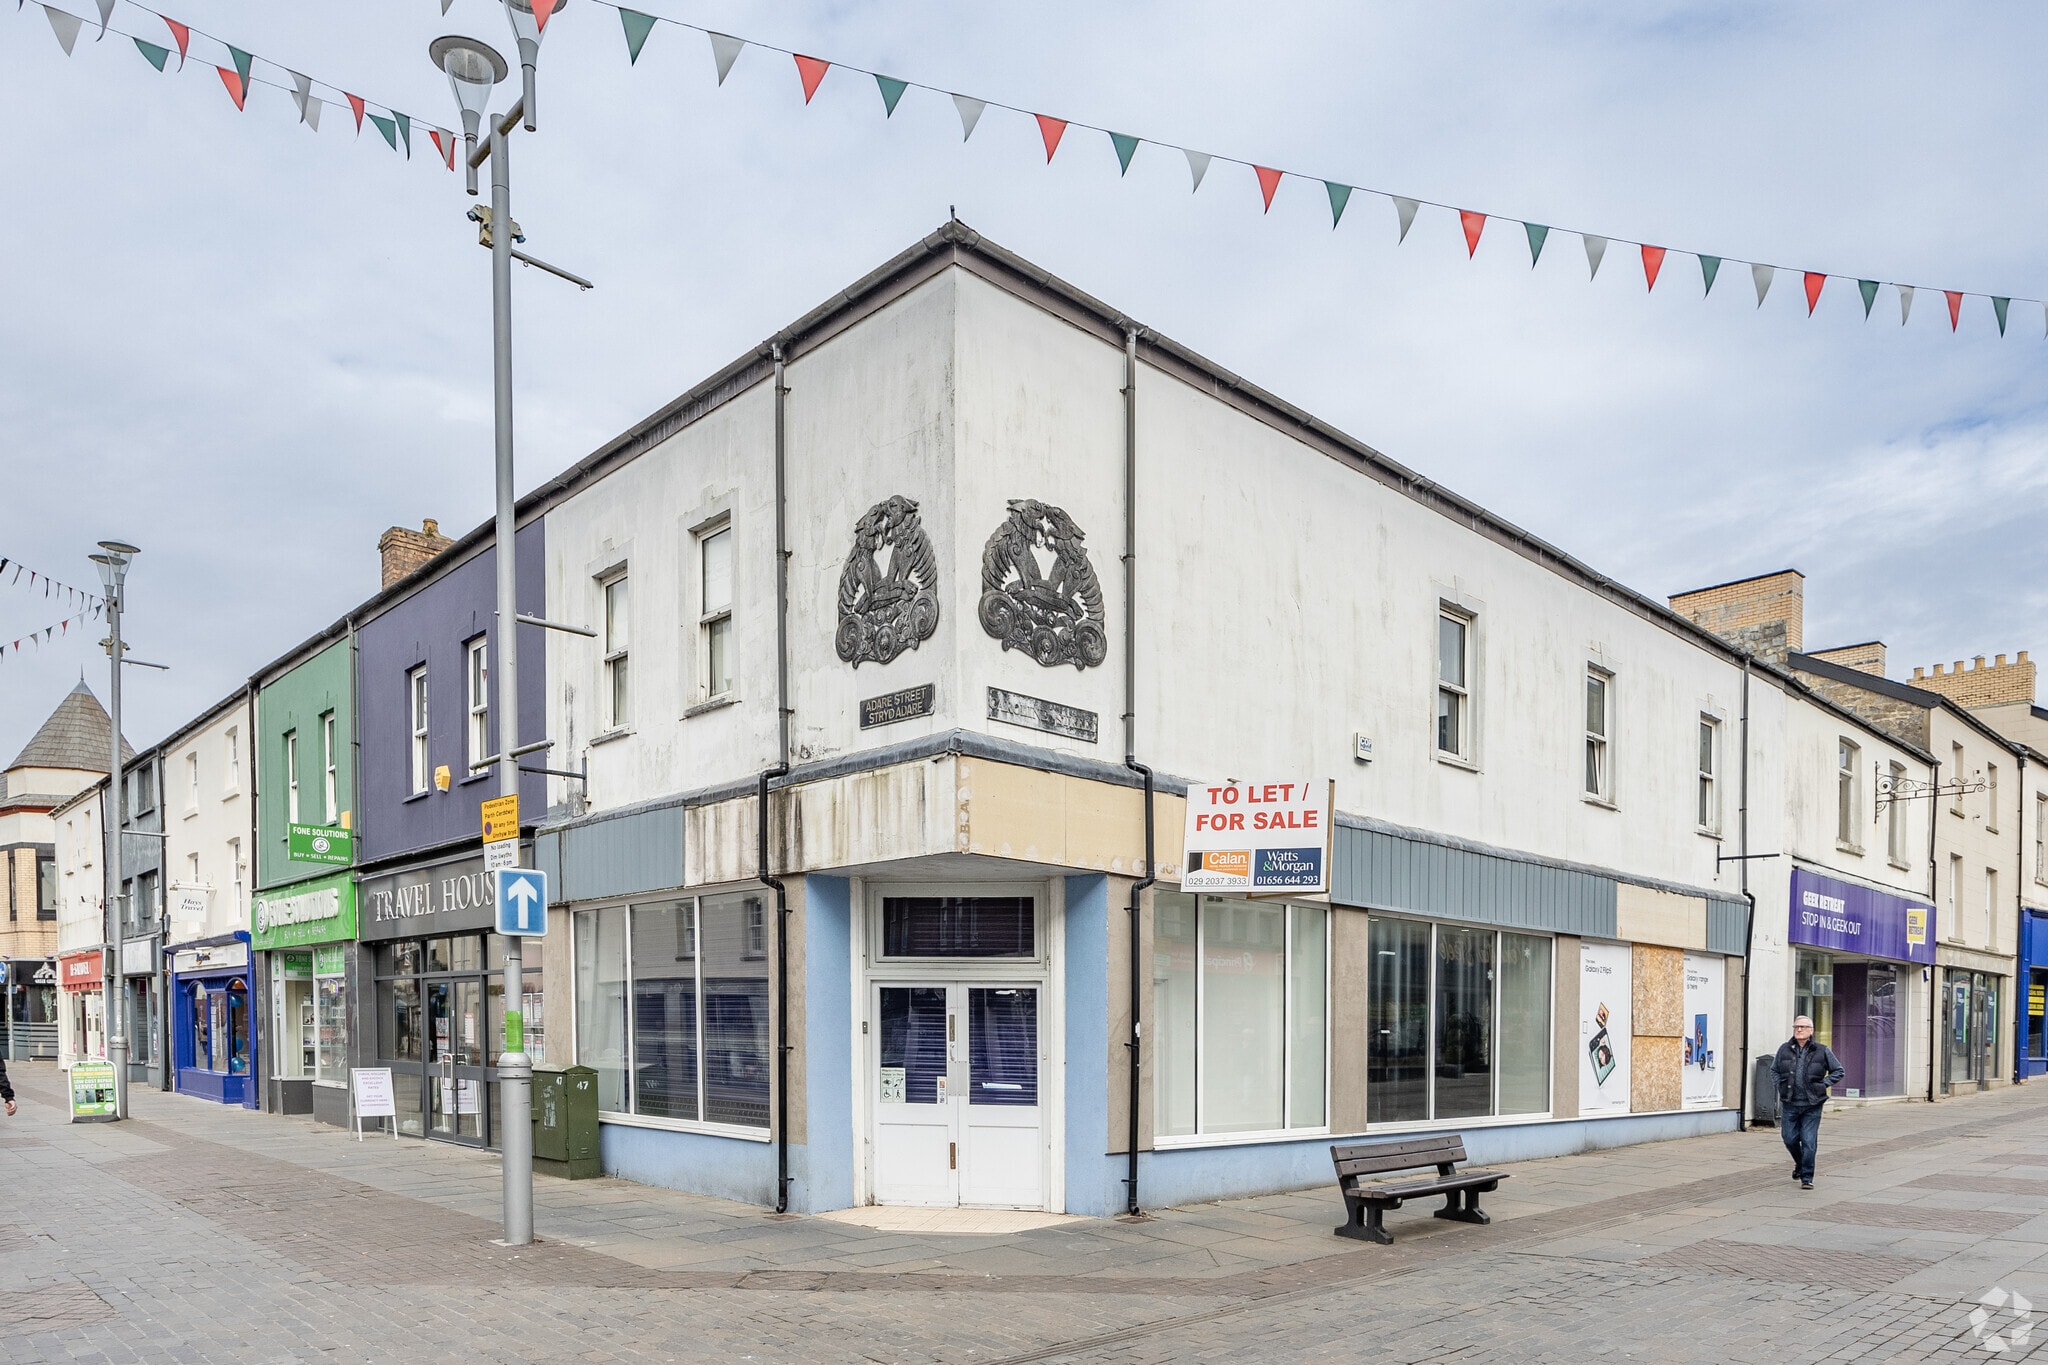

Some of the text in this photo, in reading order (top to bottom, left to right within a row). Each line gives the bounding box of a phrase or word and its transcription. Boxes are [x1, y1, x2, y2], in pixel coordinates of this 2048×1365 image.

[866, 687, 927, 713] ADARE STREET
[869, 701, 923, 724] STRYD ADARE
[1207, 782, 1309, 805] TO LET /
[484, 802, 504, 810] Pedestrian
[1196, 809, 1318, 832] FOR SALE
[293, 826, 348, 840] FONE SOLUTIONS
[497, 842, 511, 850] loading
[1267, 850, 1299, 862] Watts
[1188, 877, 1247, 885] 029 2037 3933
[1256, 875, 1318, 885] 01656 644 293
[183, 898, 202, 906] Hays
[373, 871, 495, 922] TRAVEL HOUS
[1803, 891, 1845, 914] GEEK RETREAT
[1802, 911, 1819, 926] STOP
[1819, 915, 1826, 928] IN
[1832, 917, 1848, 933] GEEK
[1848, 921, 1861, 935] OUT
[1585, 965, 1599, 974] Galaxy
[577, 1081, 589, 1090] 47
